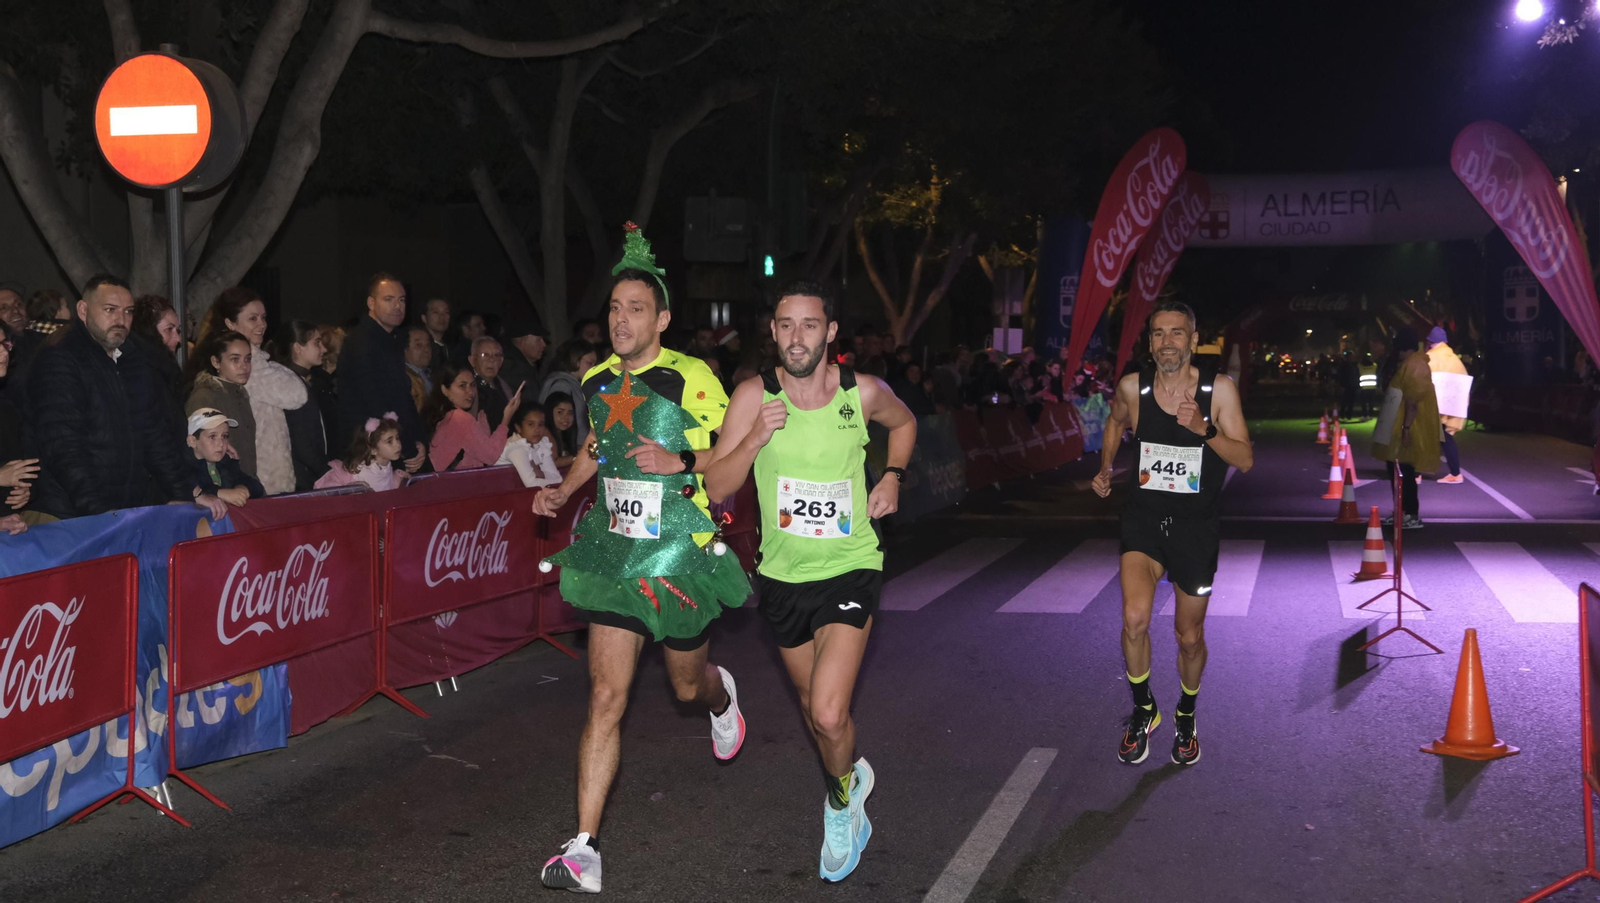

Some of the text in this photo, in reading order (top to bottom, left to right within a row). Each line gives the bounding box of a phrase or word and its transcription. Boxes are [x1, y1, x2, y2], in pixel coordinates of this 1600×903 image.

[1093, 136, 1180, 288] Coca-Cola
[1260, 184, 1401, 218] ALMERÍA
[1137, 177, 1206, 301] Coca-Cola
[1259, 221, 1331, 237] CIUDAD
[1151, 460, 1187, 476] 448
[614, 498, 643, 518] 340
[793, 498, 837, 518] 263
[424, 508, 514, 588] Coca-Cola
[217, 538, 336, 646] Coca-Cola
